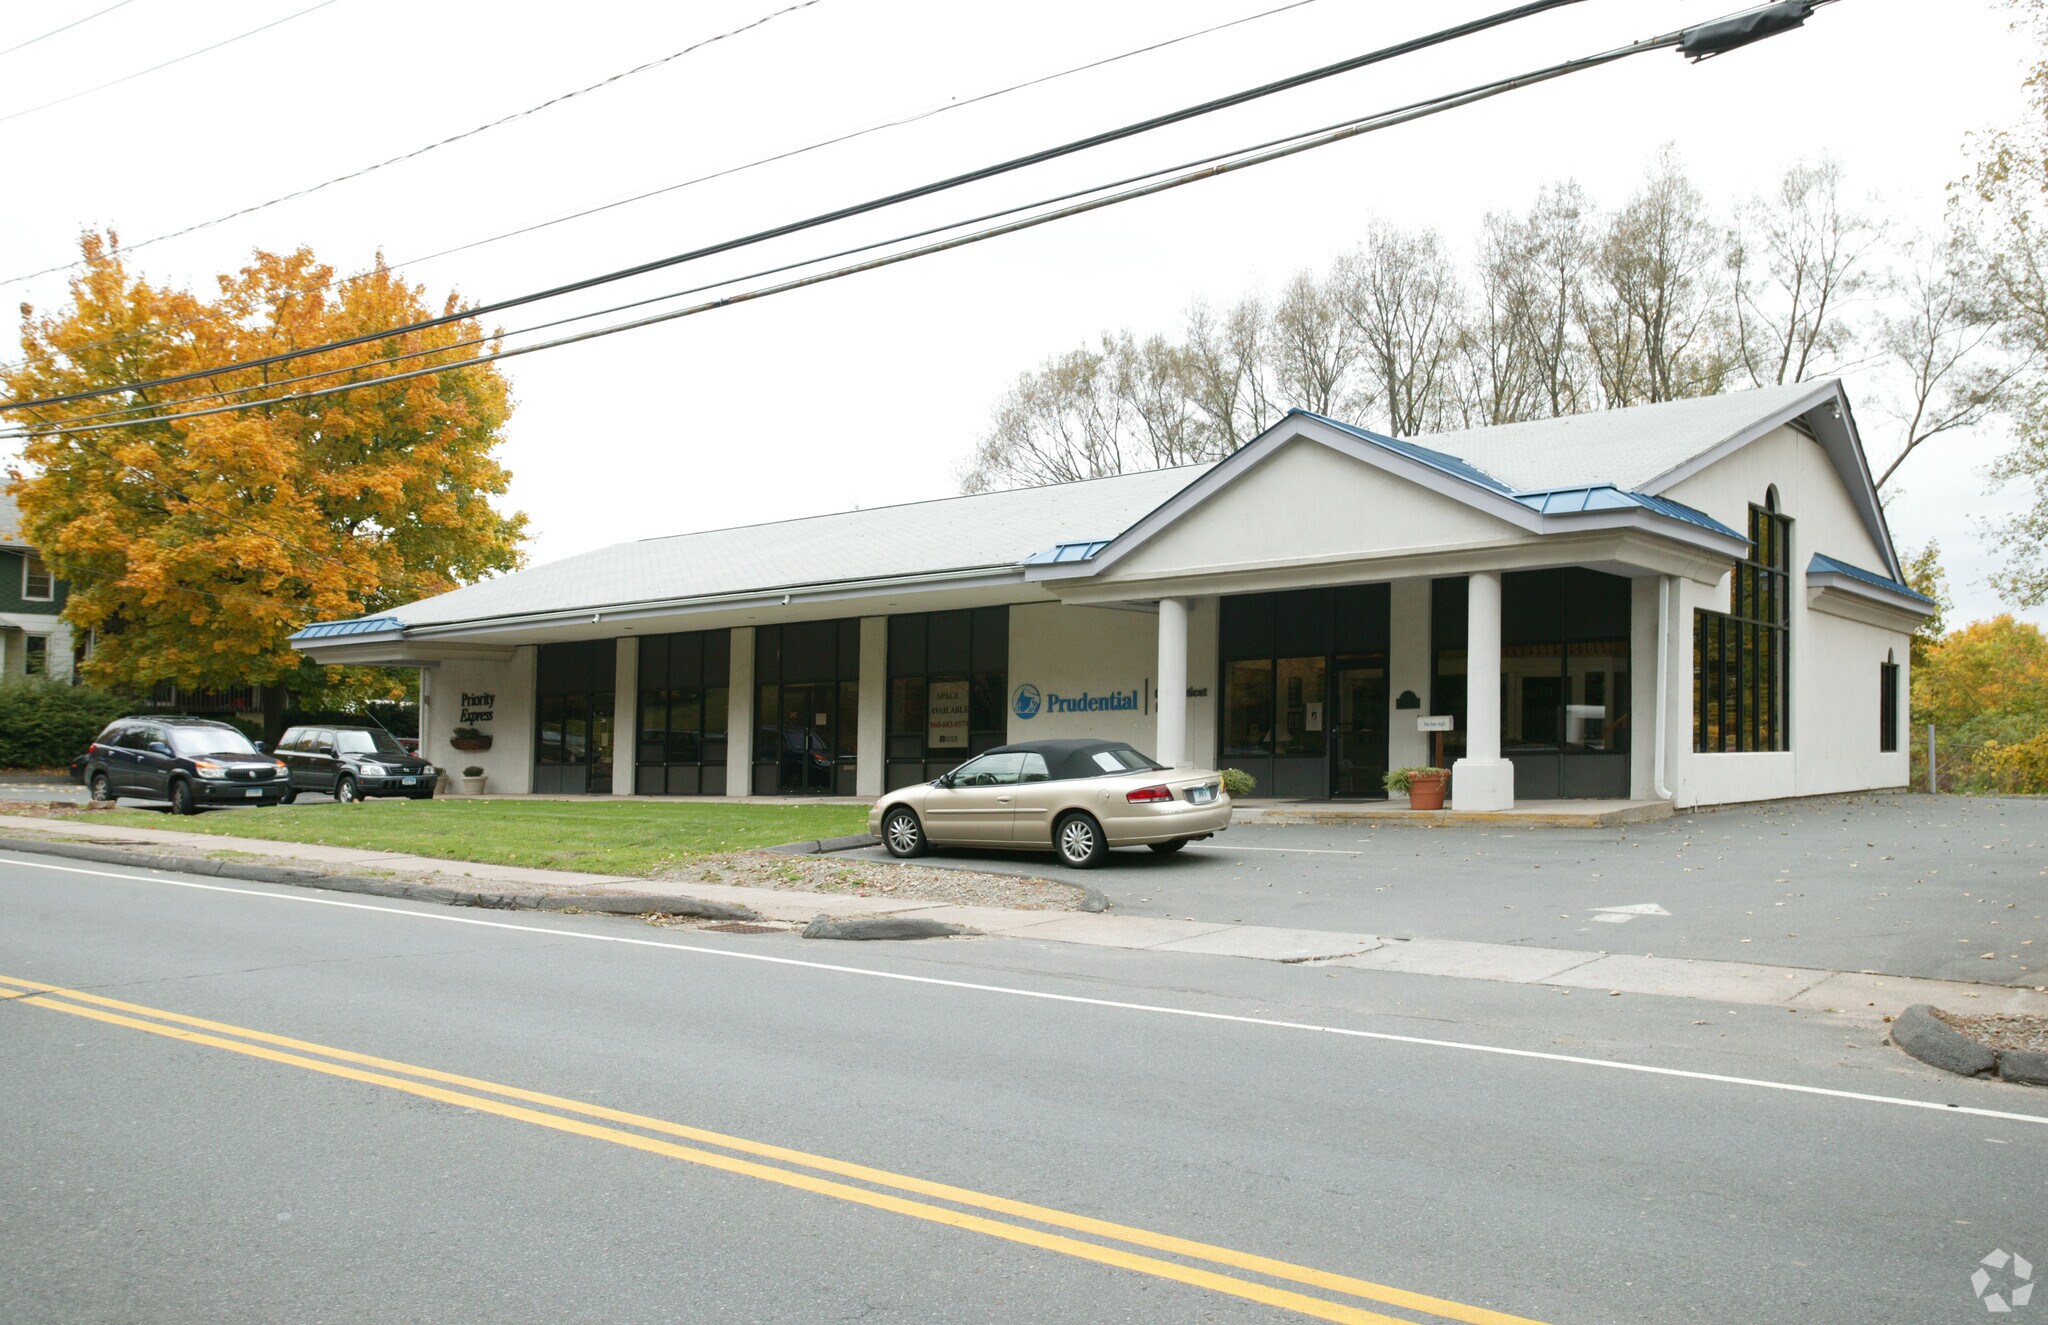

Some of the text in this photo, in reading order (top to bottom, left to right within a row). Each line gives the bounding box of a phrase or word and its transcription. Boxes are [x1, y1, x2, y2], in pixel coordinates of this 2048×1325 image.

[461, 692, 495, 708] Priority
[937, 692, 959, 700] SPACE
[1047, 690, 1138, 713] Prudential
[460, 709, 494, 726] Express
[931, 706, 969, 715] AVAILABLE
